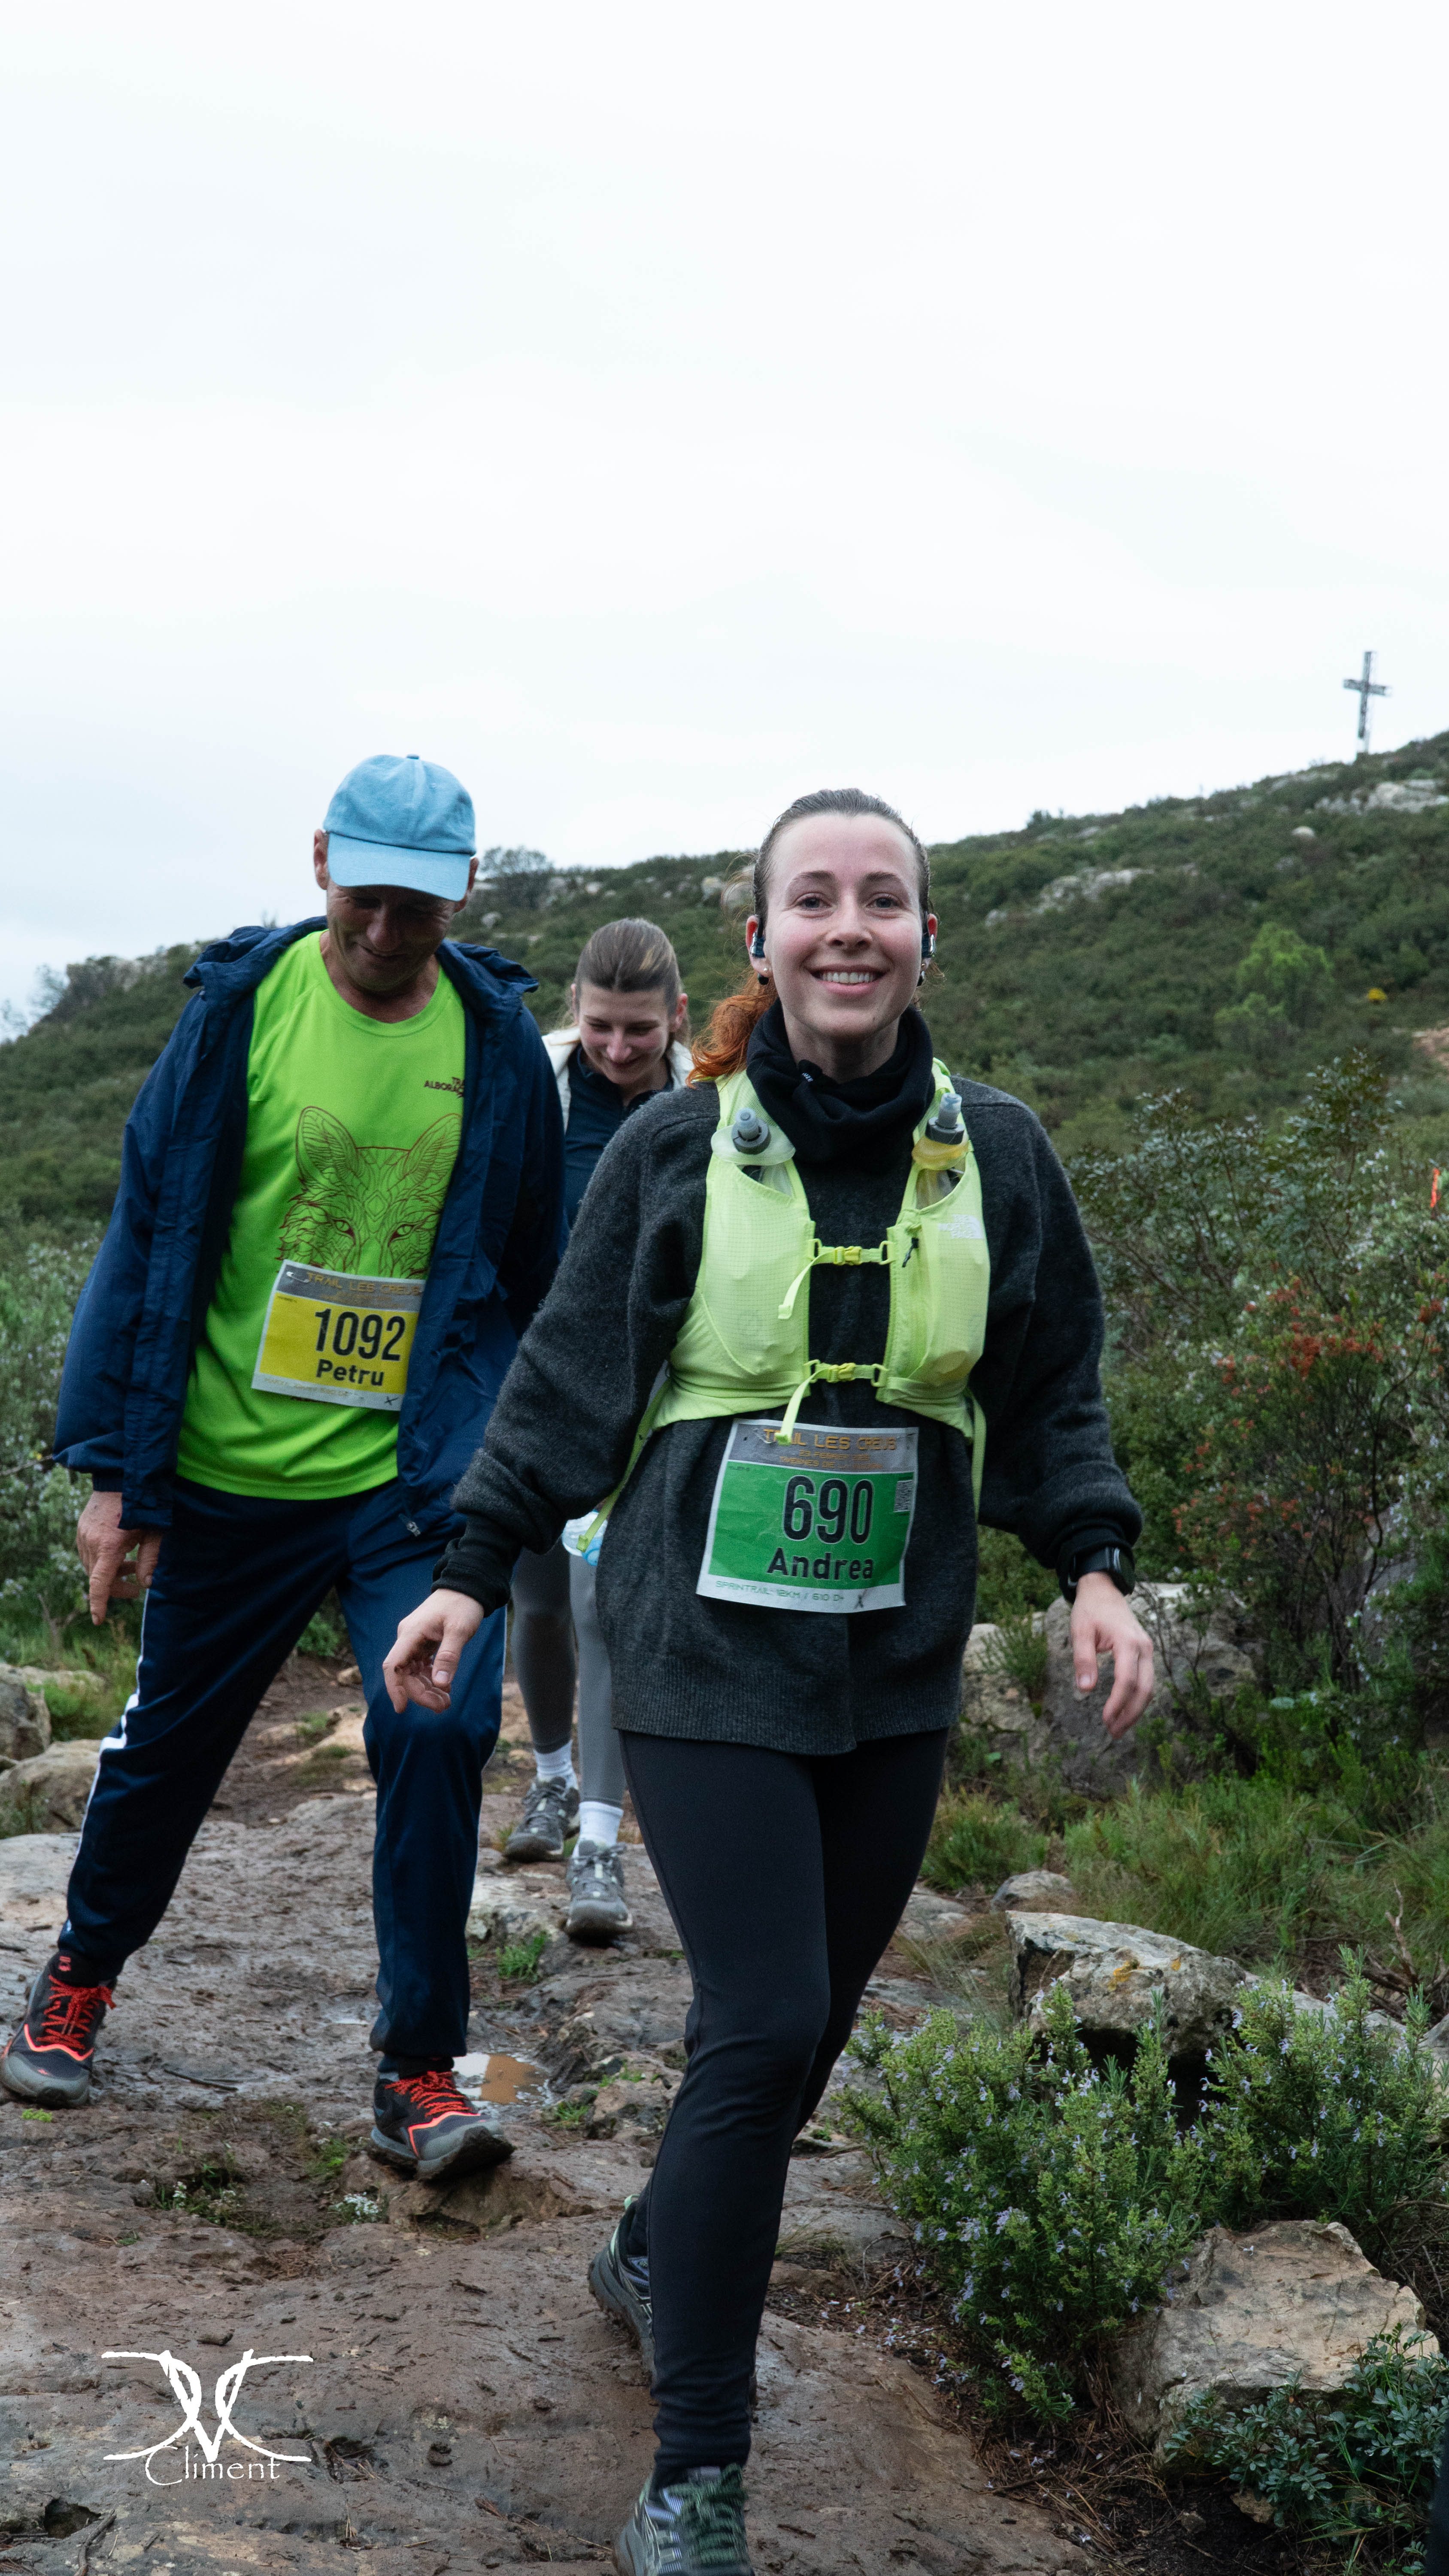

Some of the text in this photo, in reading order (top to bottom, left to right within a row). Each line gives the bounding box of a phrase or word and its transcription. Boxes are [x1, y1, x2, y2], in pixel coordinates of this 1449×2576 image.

[349, 1281, 375, 1293] LES
[315, 1308, 406, 1361] 1092
[316, 1359, 385, 1387] Petru
[763, 1428, 897, 1450] TIL LES CREUS
[782, 1475, 874, 1545] 690
[767, 1547, 874, 1581] Andrea
